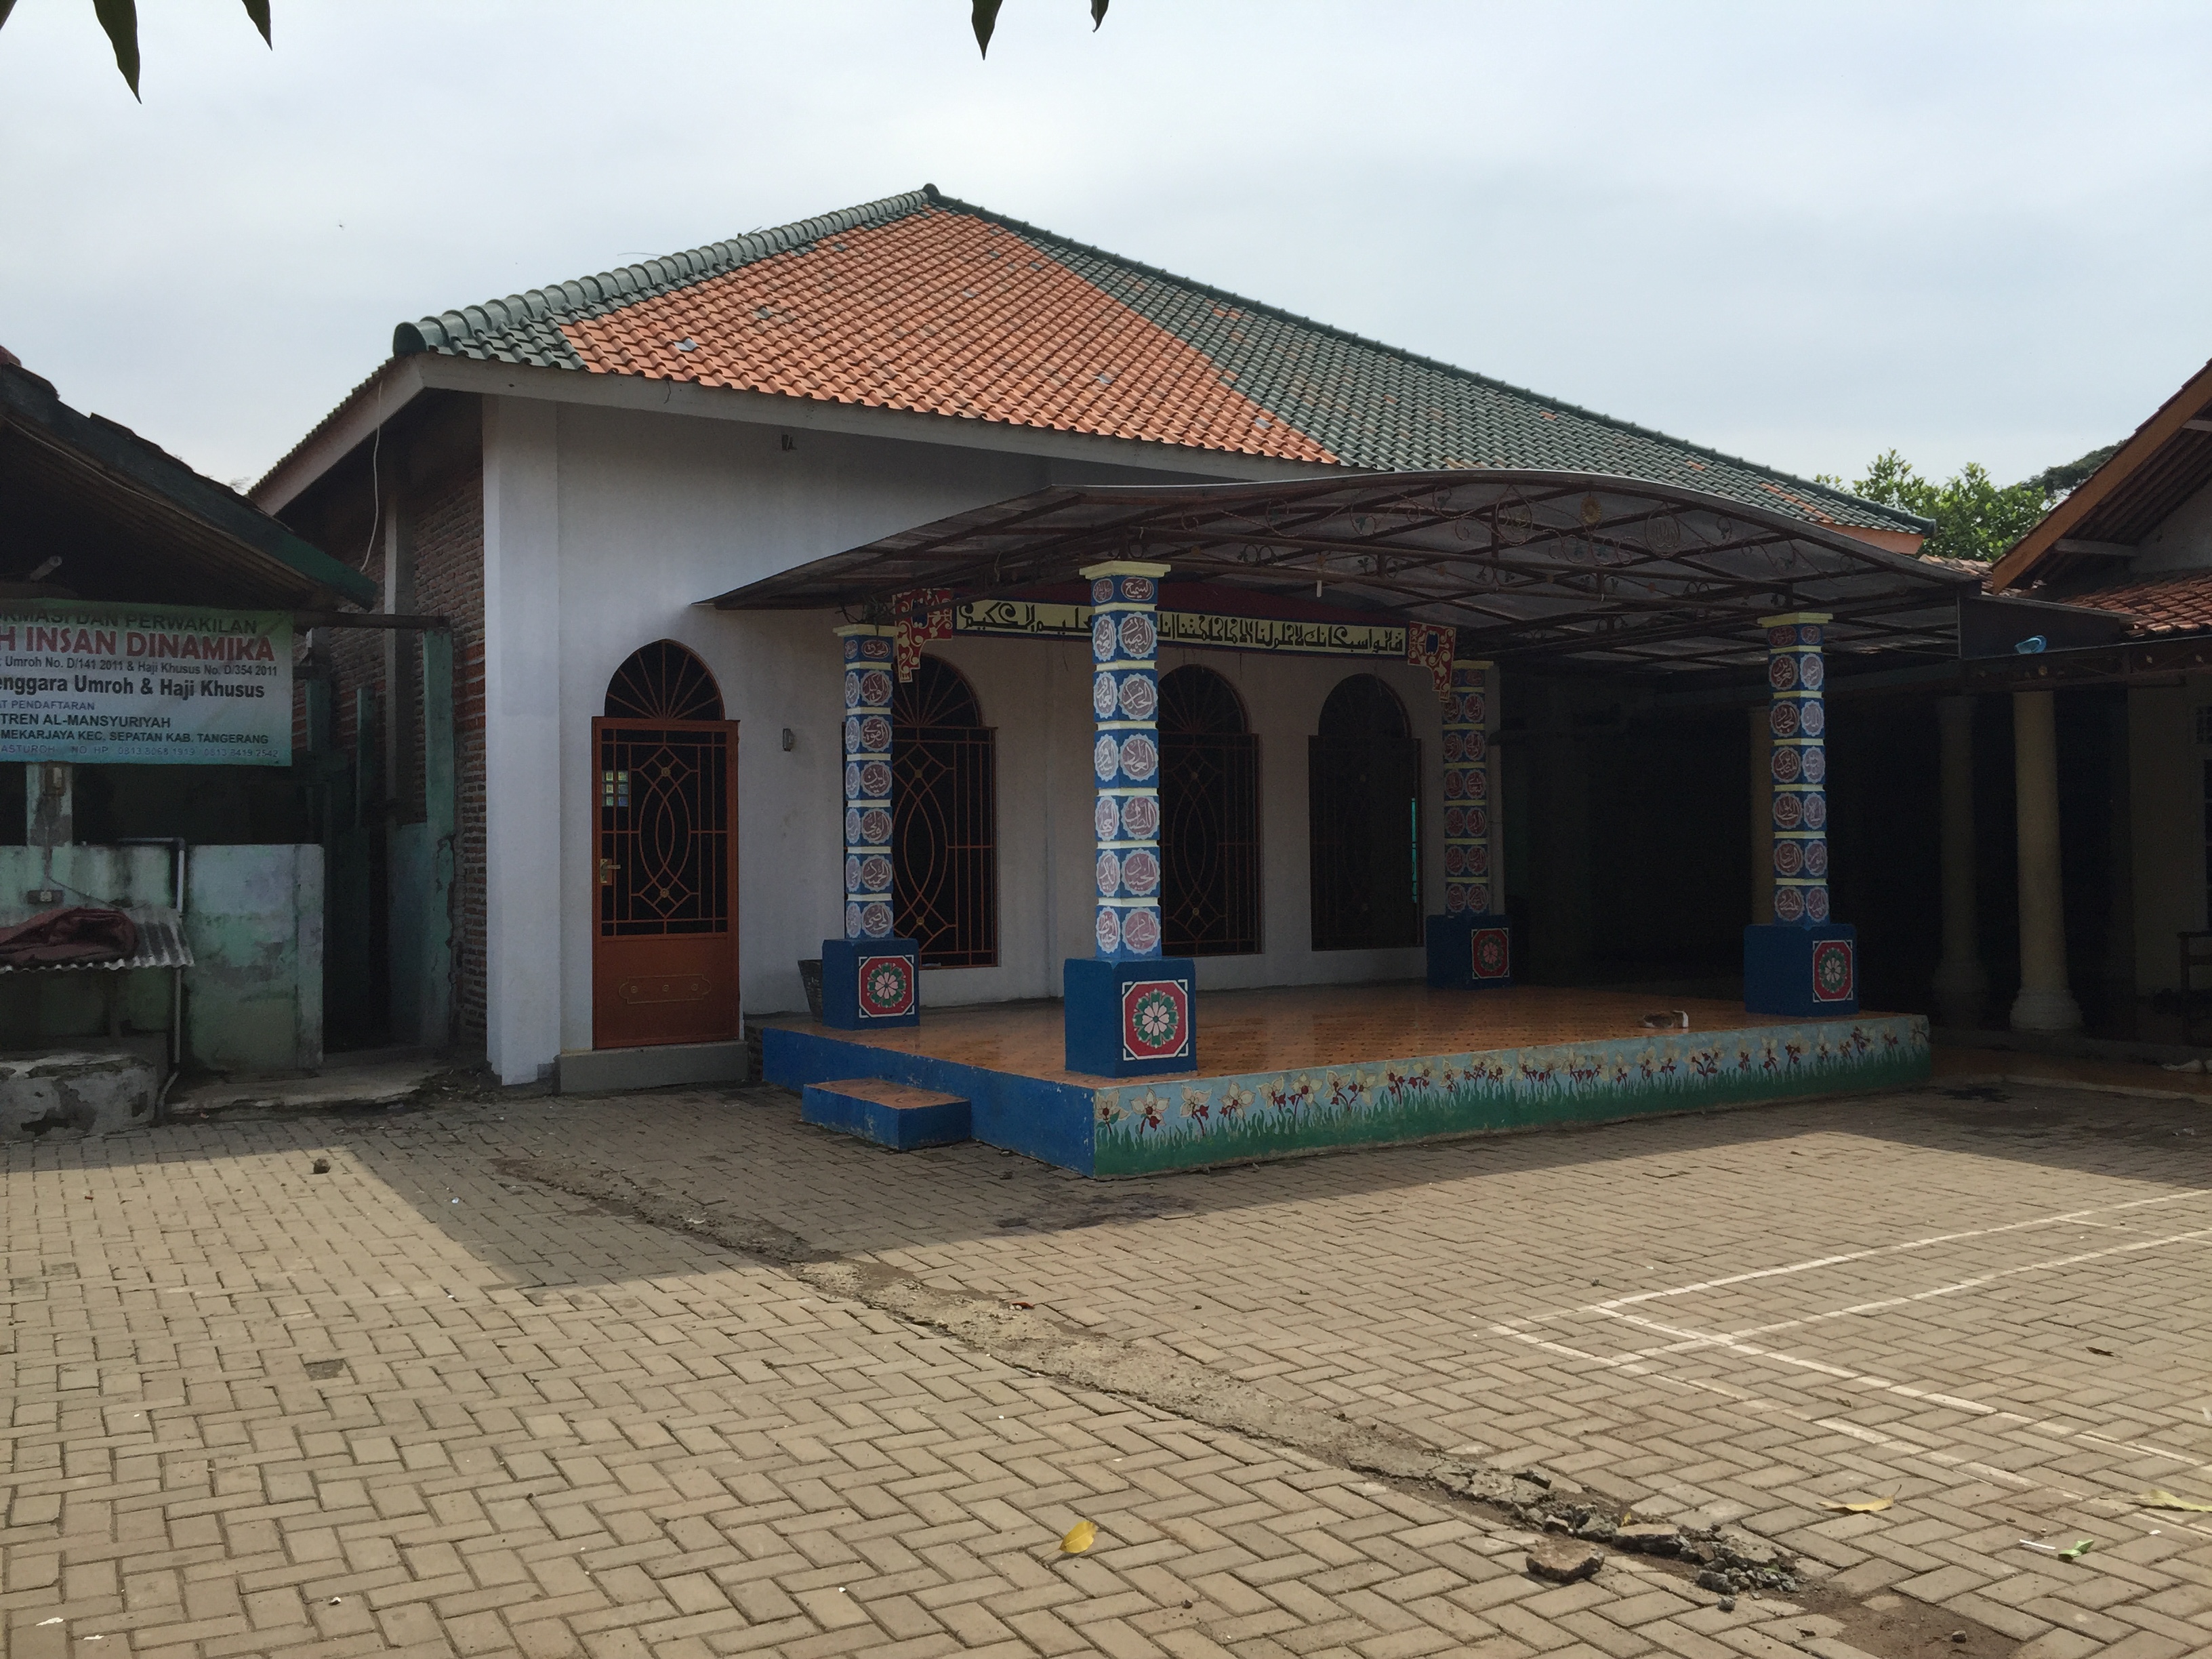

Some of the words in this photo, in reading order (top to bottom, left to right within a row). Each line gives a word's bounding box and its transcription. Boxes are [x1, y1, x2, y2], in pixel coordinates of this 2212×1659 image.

[125, 612, 257, 634] PERWAKILAN
[26, 626, 117, 655] INSAN
[126, 631, 275, 662] DINAMIKA
[5, 655, 42, 668] Umroh
[45, 656, 64, 668] No.
[99, 659, 123, 671] 2011
[127, 661, 135, 672] &
[138, 662, 158, 675] Haji
[161, 662, 201, 675] Khusus
[204, 664, 220, 676] No.
[255, 665, 278, 676] 2011
[0, 676, 68, 695] nggara
[74, 674, 134, 695] Umroh
[140, 678, 154, 695] &
[160, 679, 194, 701] Haji
[201, 680, 265, 698] Khusus
[11, 700, 95, 710] PENDAFTARAN
[43, 714, 171, 729] AL-MANSYURIYAH
[1, 729, 75, 740] MEKARJAYA
[77, 731, 106, 741] KEC.
[109, 732, 163, 742] SEPATAN
[166, 733, 194, 743] KAB.
[197, 733, 269, 744] TANGERANG
